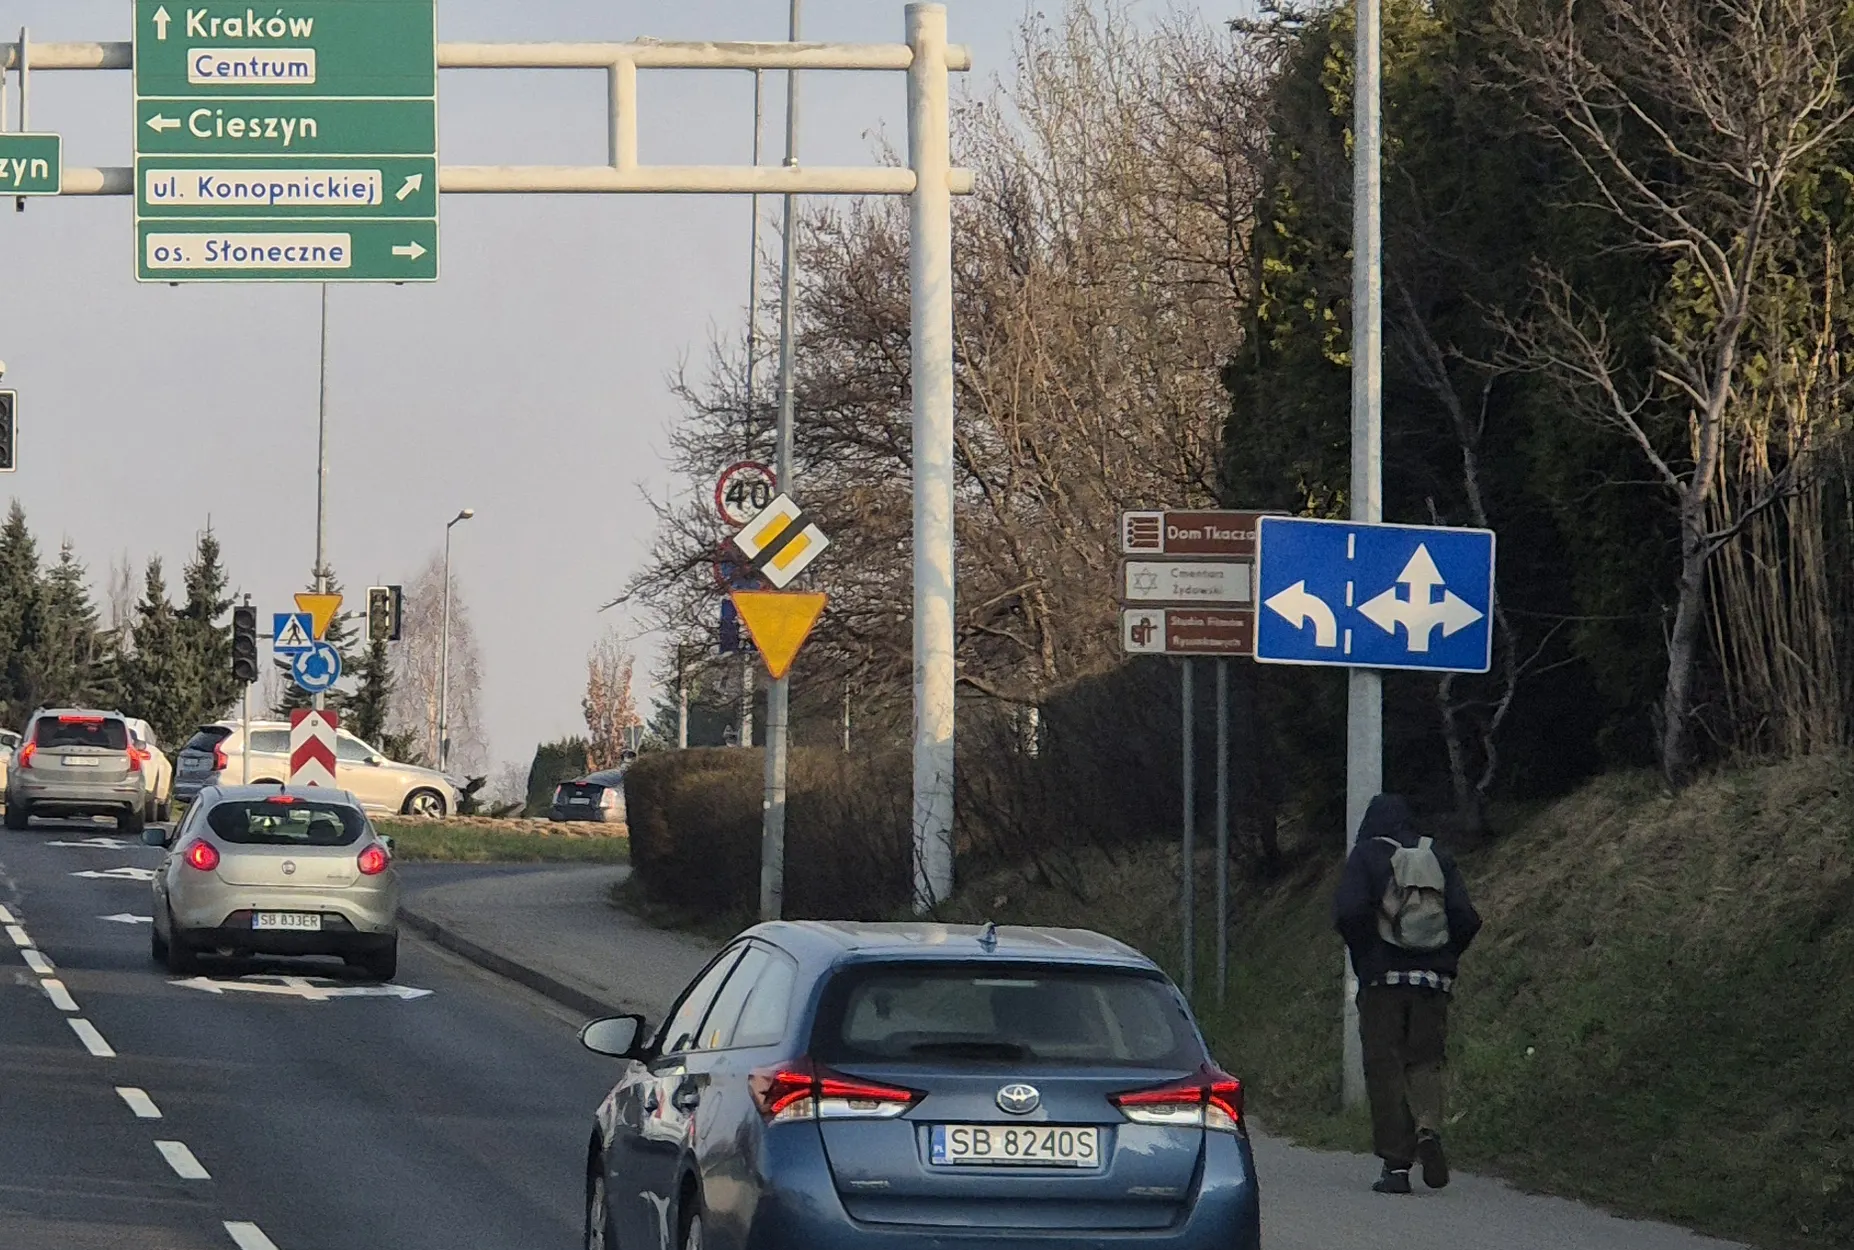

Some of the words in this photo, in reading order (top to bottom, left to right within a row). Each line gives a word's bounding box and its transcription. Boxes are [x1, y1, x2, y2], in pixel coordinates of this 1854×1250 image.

[186, 8, 314, 38] Kraków
[195, 54, 309, 78] Centrum
[188, 108, 318, 147] Cieszyn
[153, 176, 185, 198] ul.
[198, 176, 376, 205] Konopnickiej
[153, 245, 191, 262] os.
[204, 240, 344, 262] Słoneczne
[725, 479, 770, 510] 40
[1167, 525, 1202, 540] Dom
[260, 914, 277, 926] SB
[950, 1128, 991, 1157] SB
[1004, 1130, 1094, 1158] 8240S
